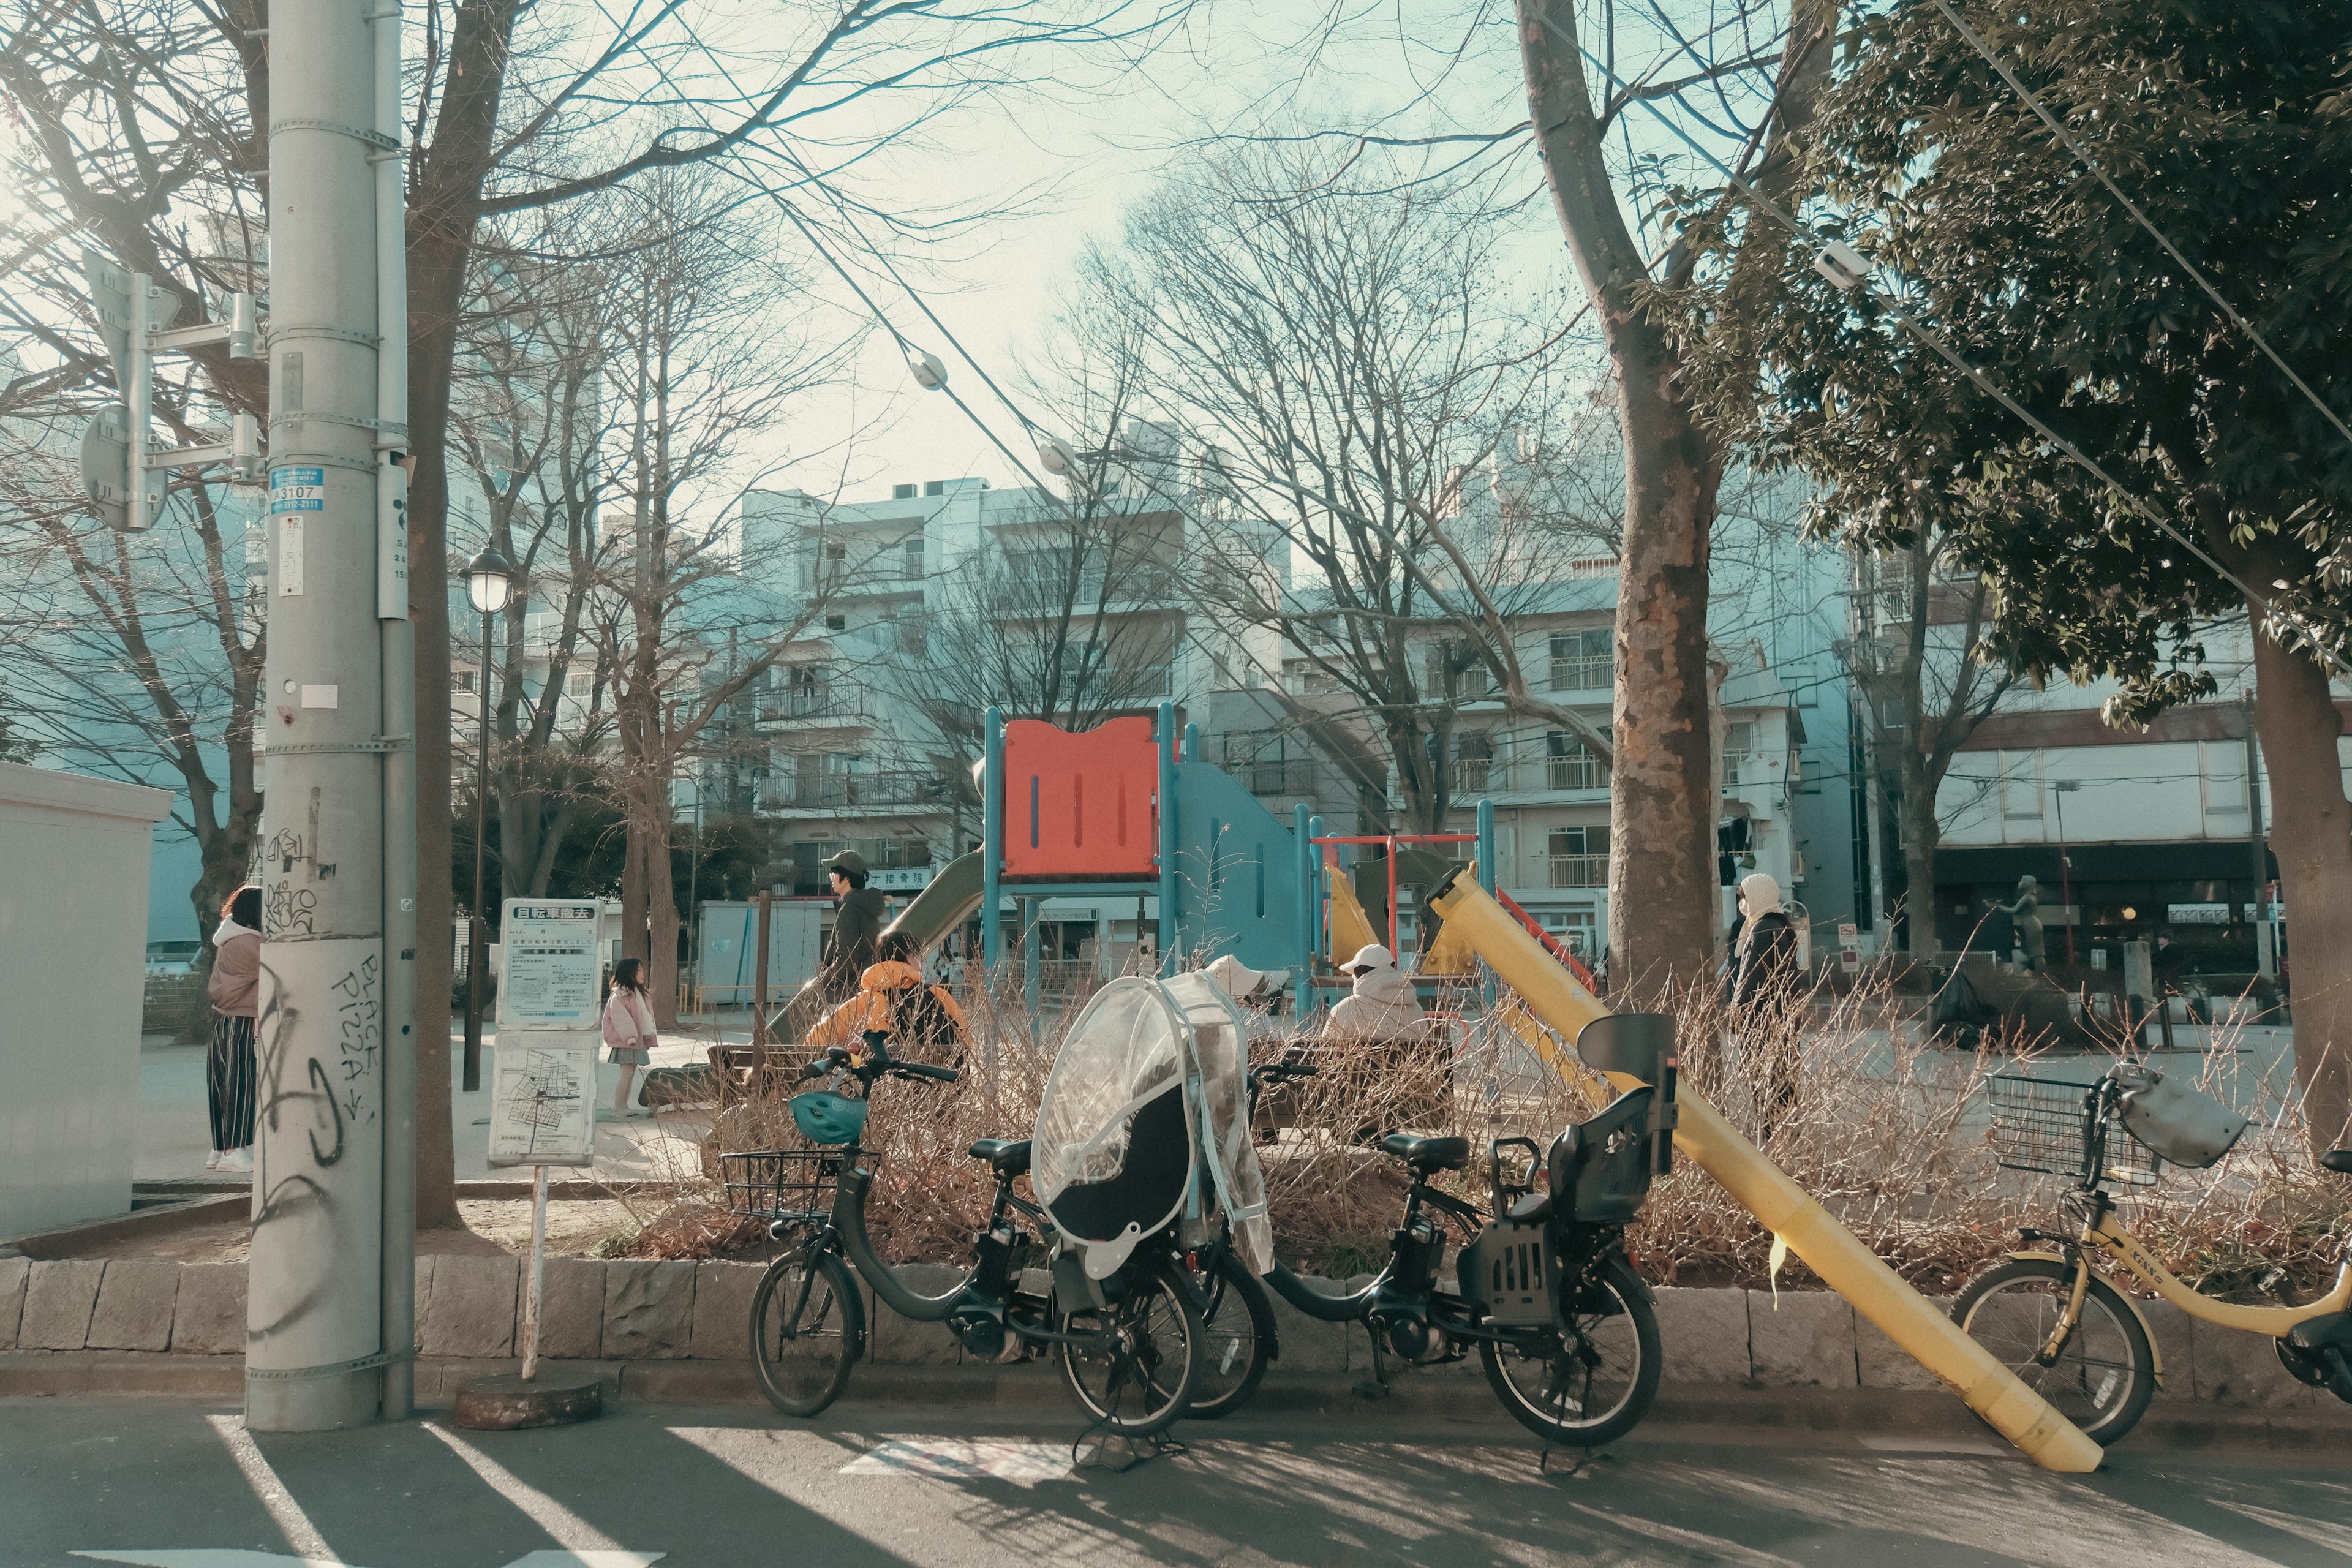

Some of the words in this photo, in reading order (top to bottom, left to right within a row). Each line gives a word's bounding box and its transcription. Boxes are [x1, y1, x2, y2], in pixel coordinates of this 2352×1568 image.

[275, 486, 314, 500] A3107
[283, 500, 318, 509] 3312-2111
[518, 908, 589, 919] 自転車撤去
[362, 954, 378, 1069] BLACK
